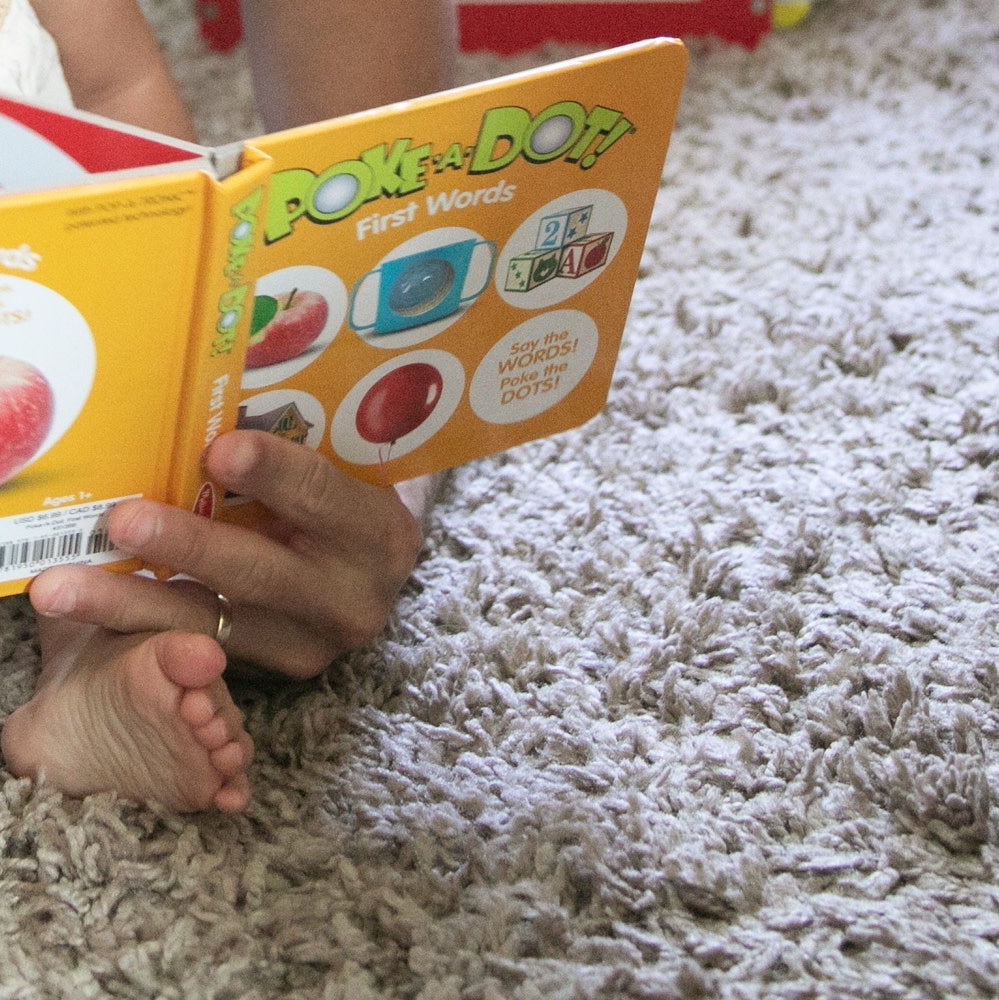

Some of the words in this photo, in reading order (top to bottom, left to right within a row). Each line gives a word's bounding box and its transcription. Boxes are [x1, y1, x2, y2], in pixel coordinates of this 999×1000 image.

[356, 200, 417, 241] First
[427, 179, 517, 216] Words
[541, 220, 561, 246] 2
[558, 247, 578, 275] A
[498, 338, 578, 375] WORDS!
[510, 339, 540, 356] Say
[543, 330, 569, 345] the
[500, 371, 539, 389] Poke
[543, 363, 568, 376] the
[501, 375, 560, 406] DOTS!
